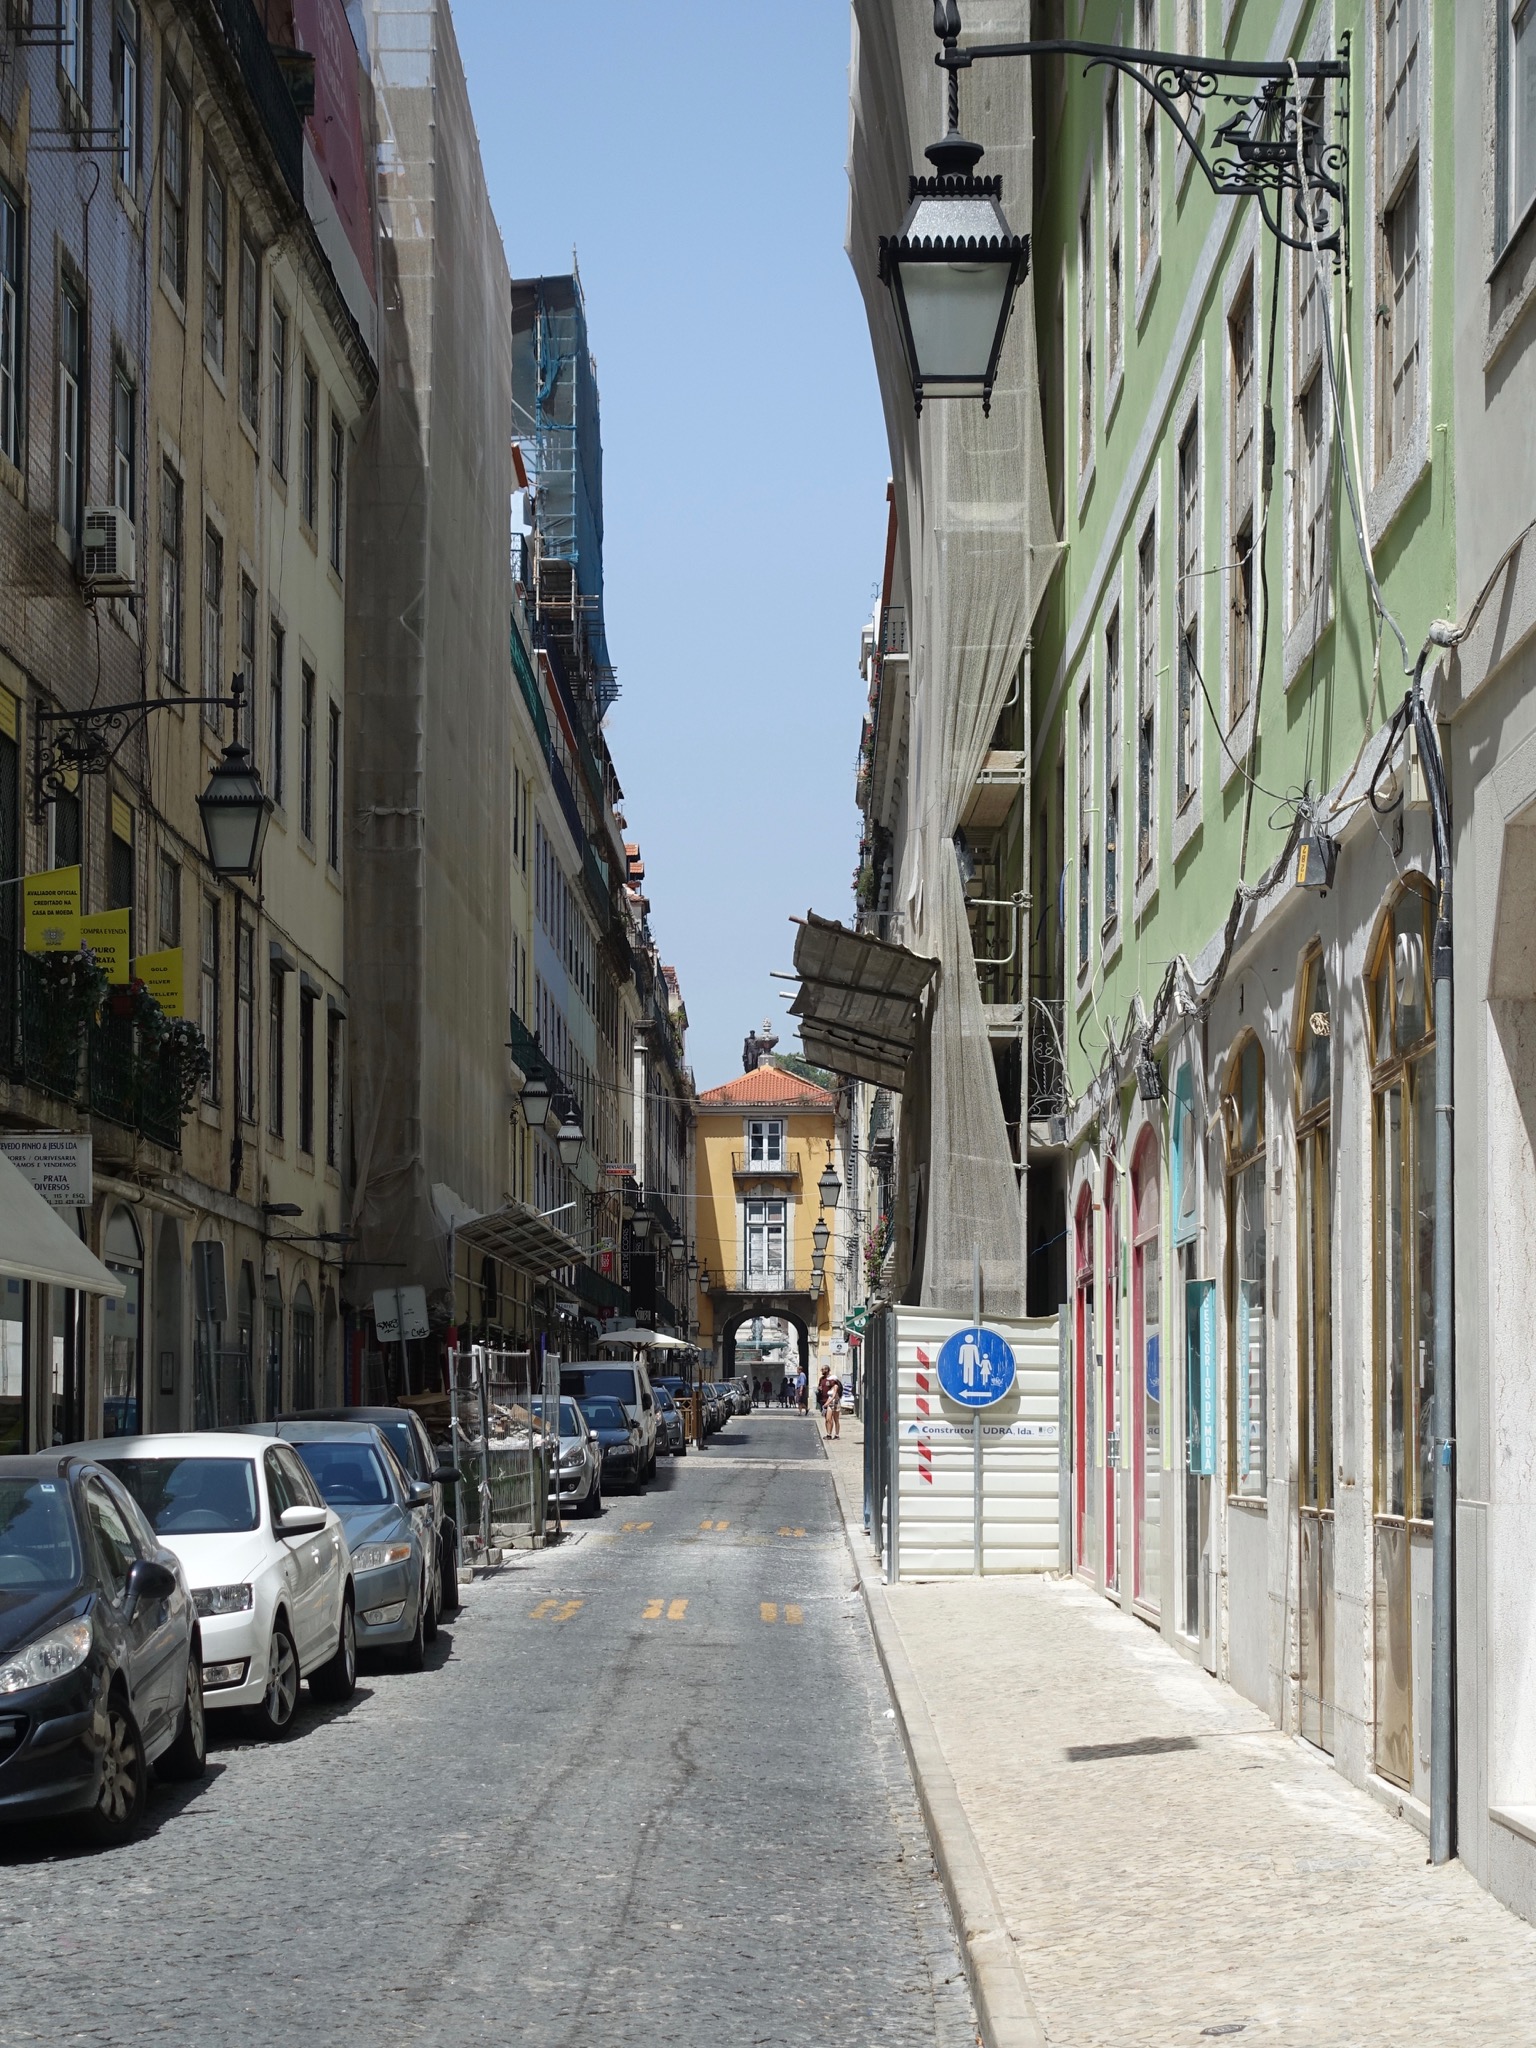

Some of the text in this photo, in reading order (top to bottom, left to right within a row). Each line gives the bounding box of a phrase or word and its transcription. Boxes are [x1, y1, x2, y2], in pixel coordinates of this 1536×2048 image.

[48, 1142, 64, 1150] JESUS
[1205, 1401, 1211, 1423] DE
[922, 1425, 973, 1434] Construtor
[983, 1426, 1015, 1435] UDRA,
